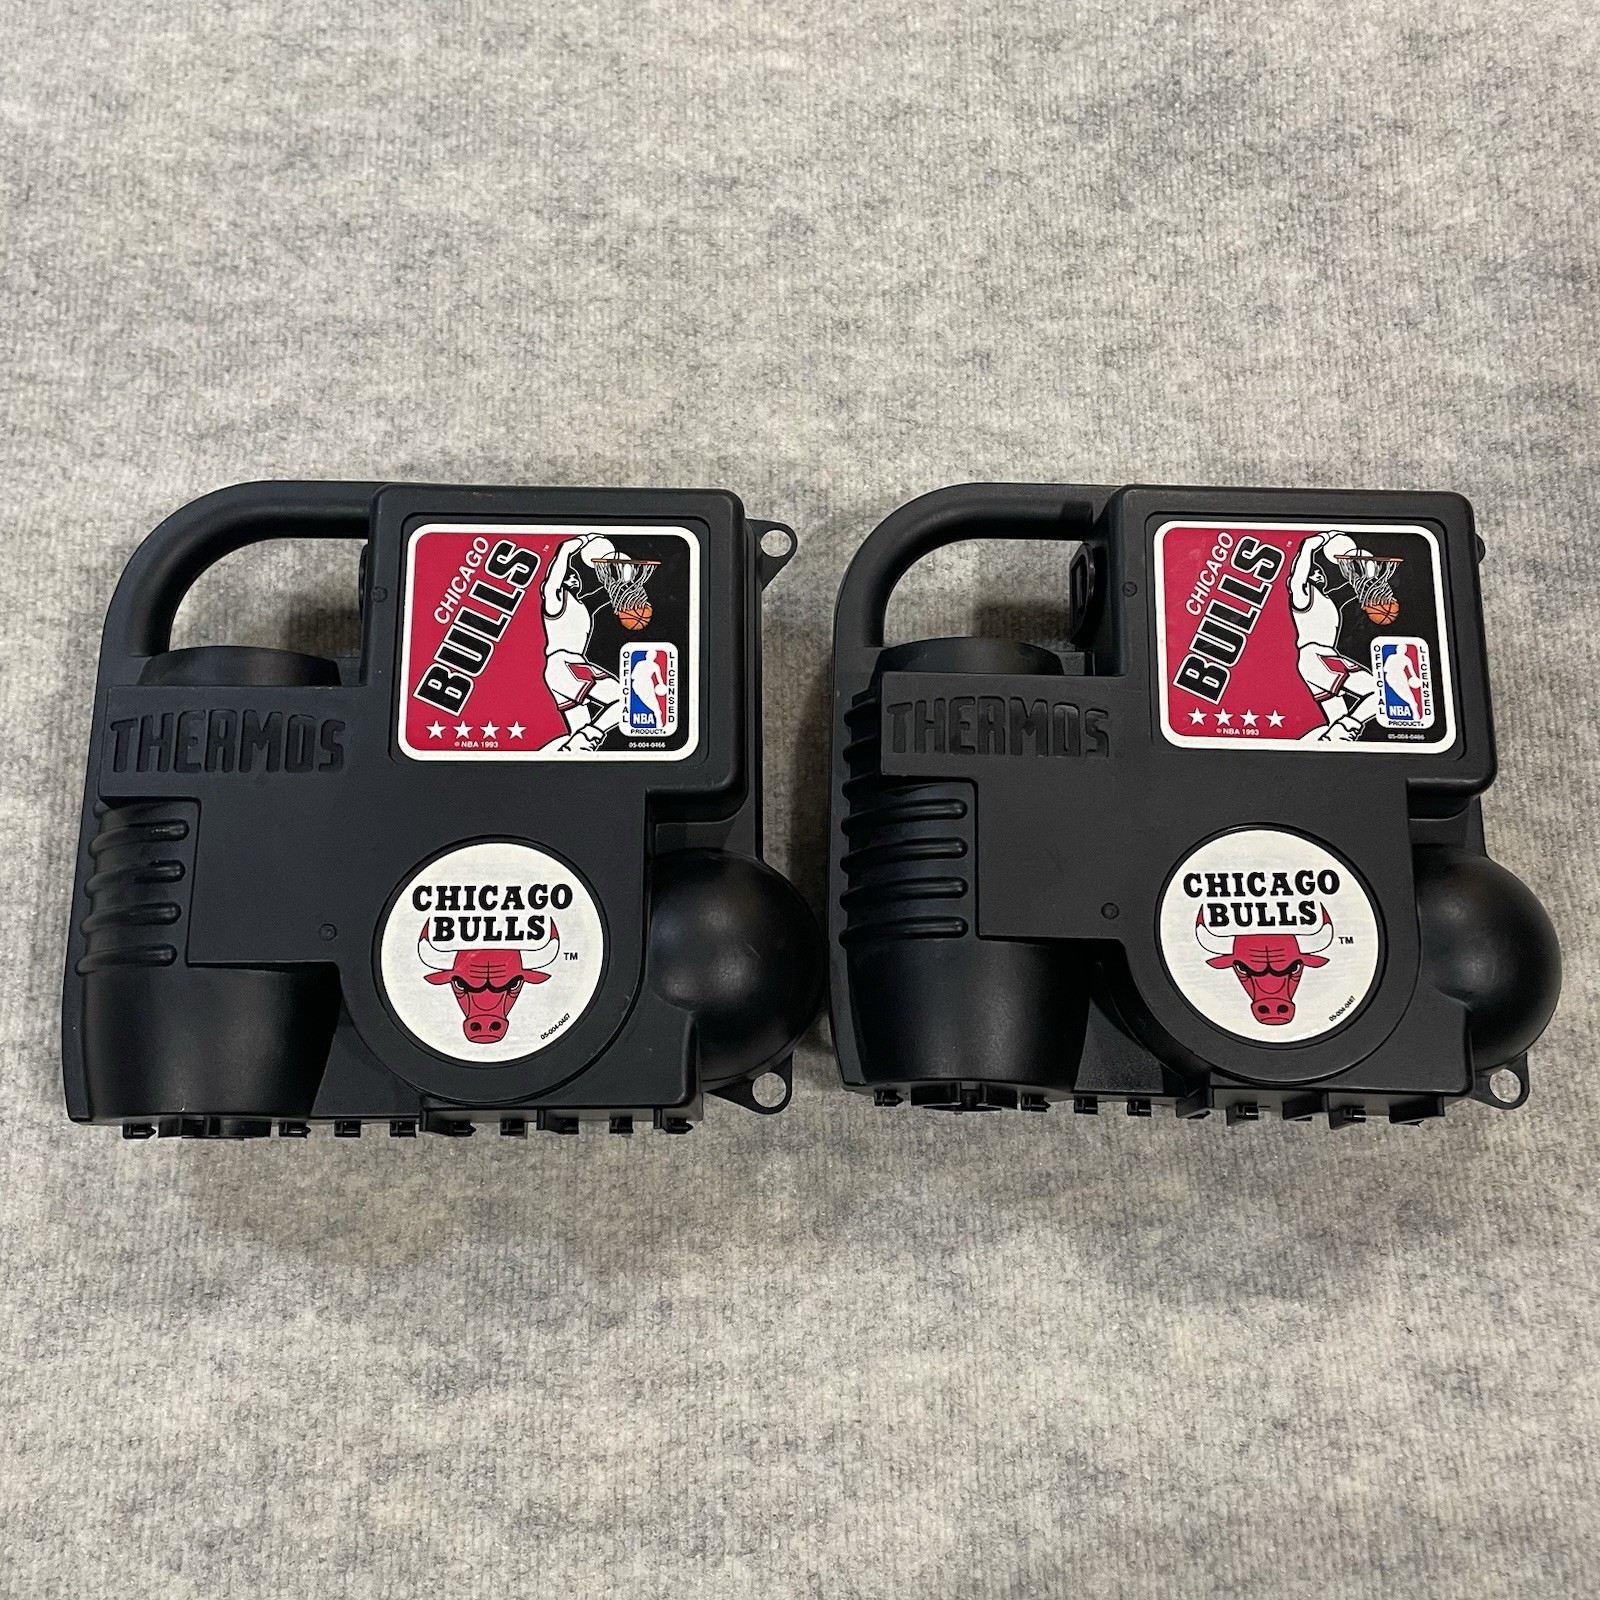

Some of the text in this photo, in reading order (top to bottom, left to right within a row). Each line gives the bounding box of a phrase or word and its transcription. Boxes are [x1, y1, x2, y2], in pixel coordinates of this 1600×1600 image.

[433, 536, 490, 624] CHICAGO
[1185, 531, 1234, 616] CHICAGO
[412, 539, 541, 717] BULLS
[1172, 535, 1286, 705] BULLS
[622, 651, 630, 723] OFFICIAL
[1373, 645, 1385, 715] OFFICIAL
[1419, 645, 1432, 716] LICENSED
[633, 712, 655, 725] NBA
[886, 695, 1110, 758] THERMOS
[1242, 728, 1259, 736] 1993
[1389, 704, 1412, 717] NBA
[110, 708, 346, 774] THERMOS
[412, 883, 573, 911] CHICAGO
[1183, 869, 1340, 898] CHICAGO
[432, 915, 545, 942] BULLS
[1207, 900, 1317, 927] BULLS
[563, 952, 578, 961] TM
[1338, 936, 1354, 944] TM
